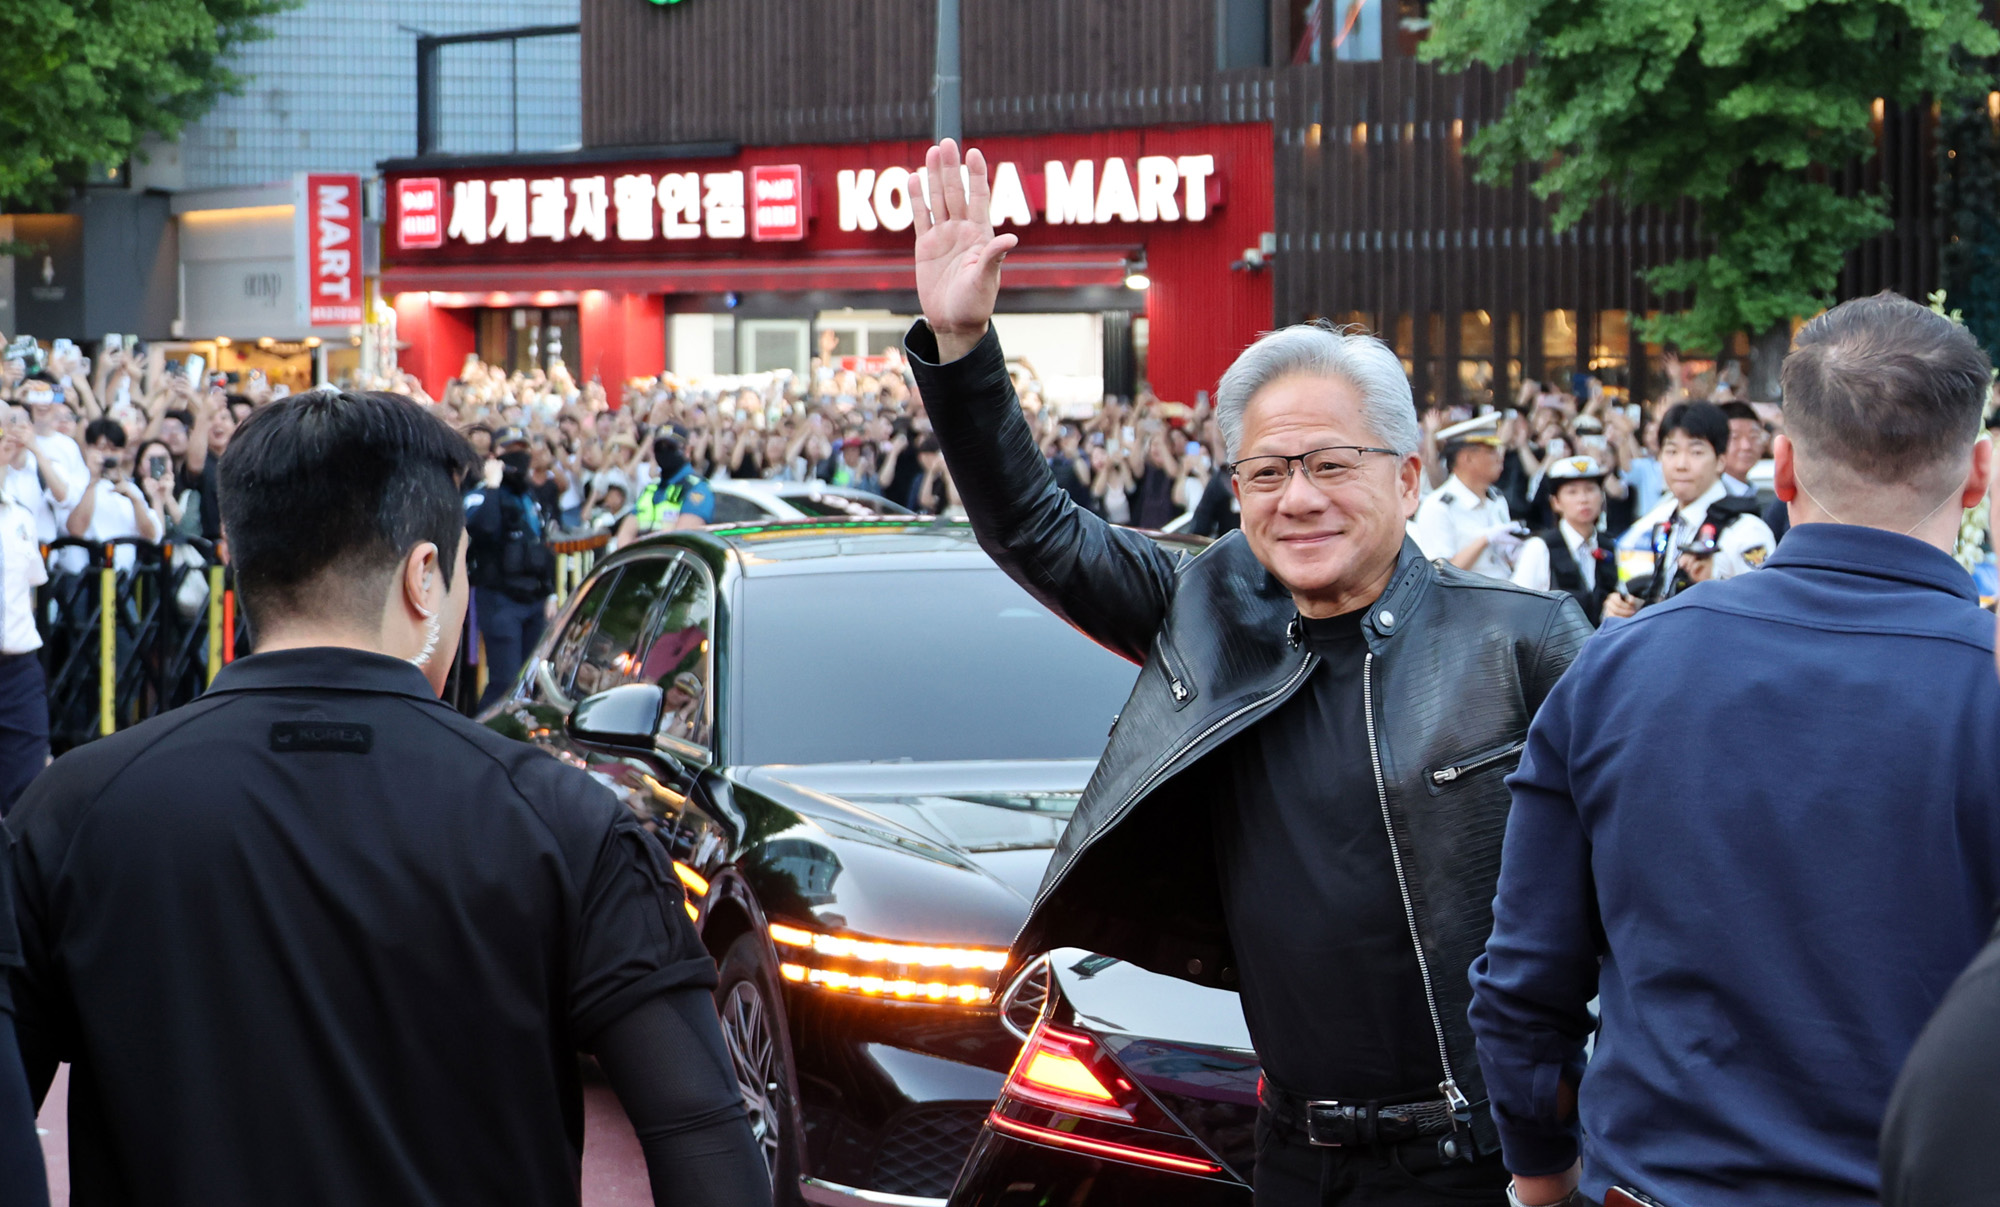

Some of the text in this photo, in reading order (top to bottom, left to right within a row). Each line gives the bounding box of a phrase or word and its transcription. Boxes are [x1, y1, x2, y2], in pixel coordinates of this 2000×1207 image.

[837, 153, 1215, 232] KOA MART
[318, 185, 350, 300] MART
